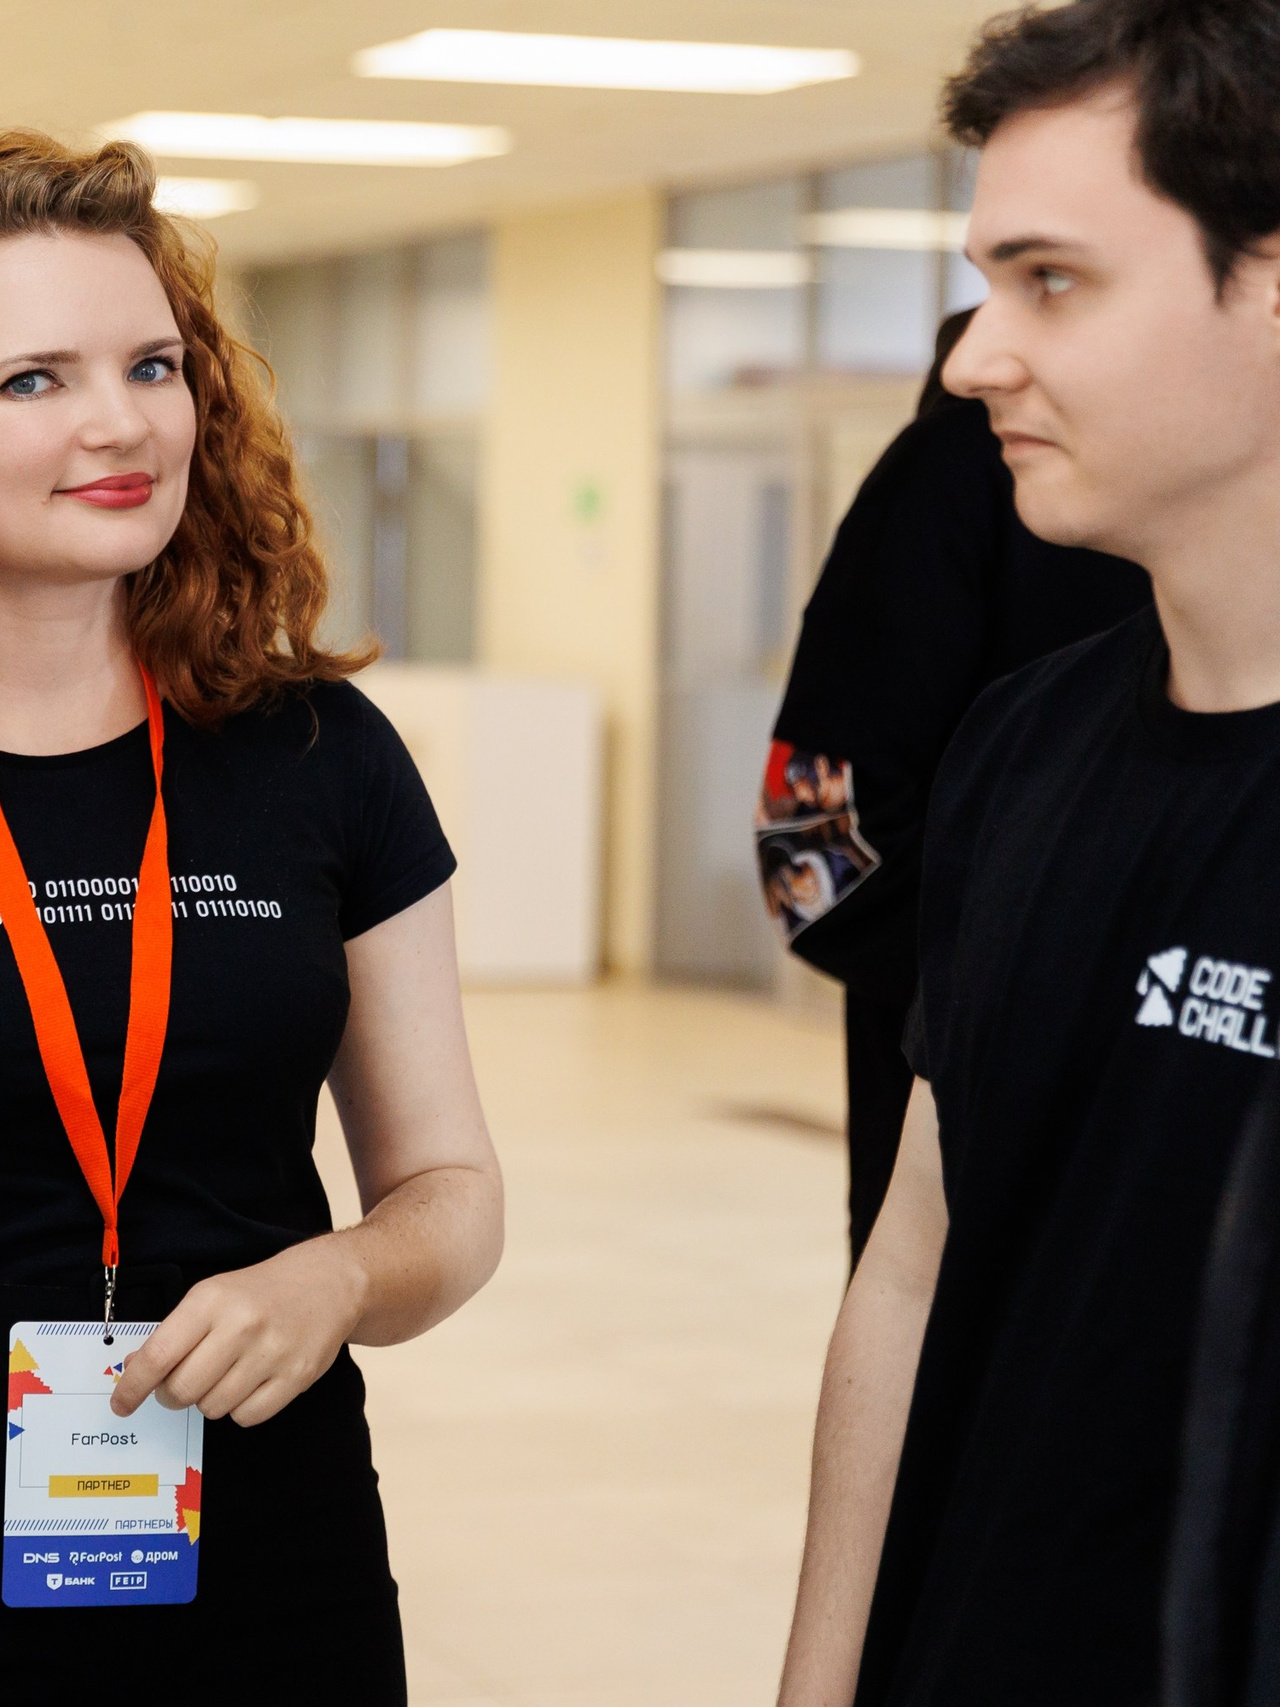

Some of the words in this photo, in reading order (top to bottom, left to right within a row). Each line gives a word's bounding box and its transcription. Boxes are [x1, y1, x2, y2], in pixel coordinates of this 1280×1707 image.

[170, 874, 238, 894] 110010
[195, 899, 283, 919] 01110100
[1188, 956, 1272, 1011] CODE
[1178, 997, 1280, 1058] CHALL
[70, 1432, 139, 1446] FarPost
[77, 1480, 131, 1491] ПАРТНЕР
[115, 1518, 174, 1530] ПАРТНЕРЫ
[23, 1552, 60, 1564] DNS
[80, 1551, 123, 1563] FarPost
[65, 1576, 96, 1586] БАНК
[114, 1576, 144, 1586] FEIP
